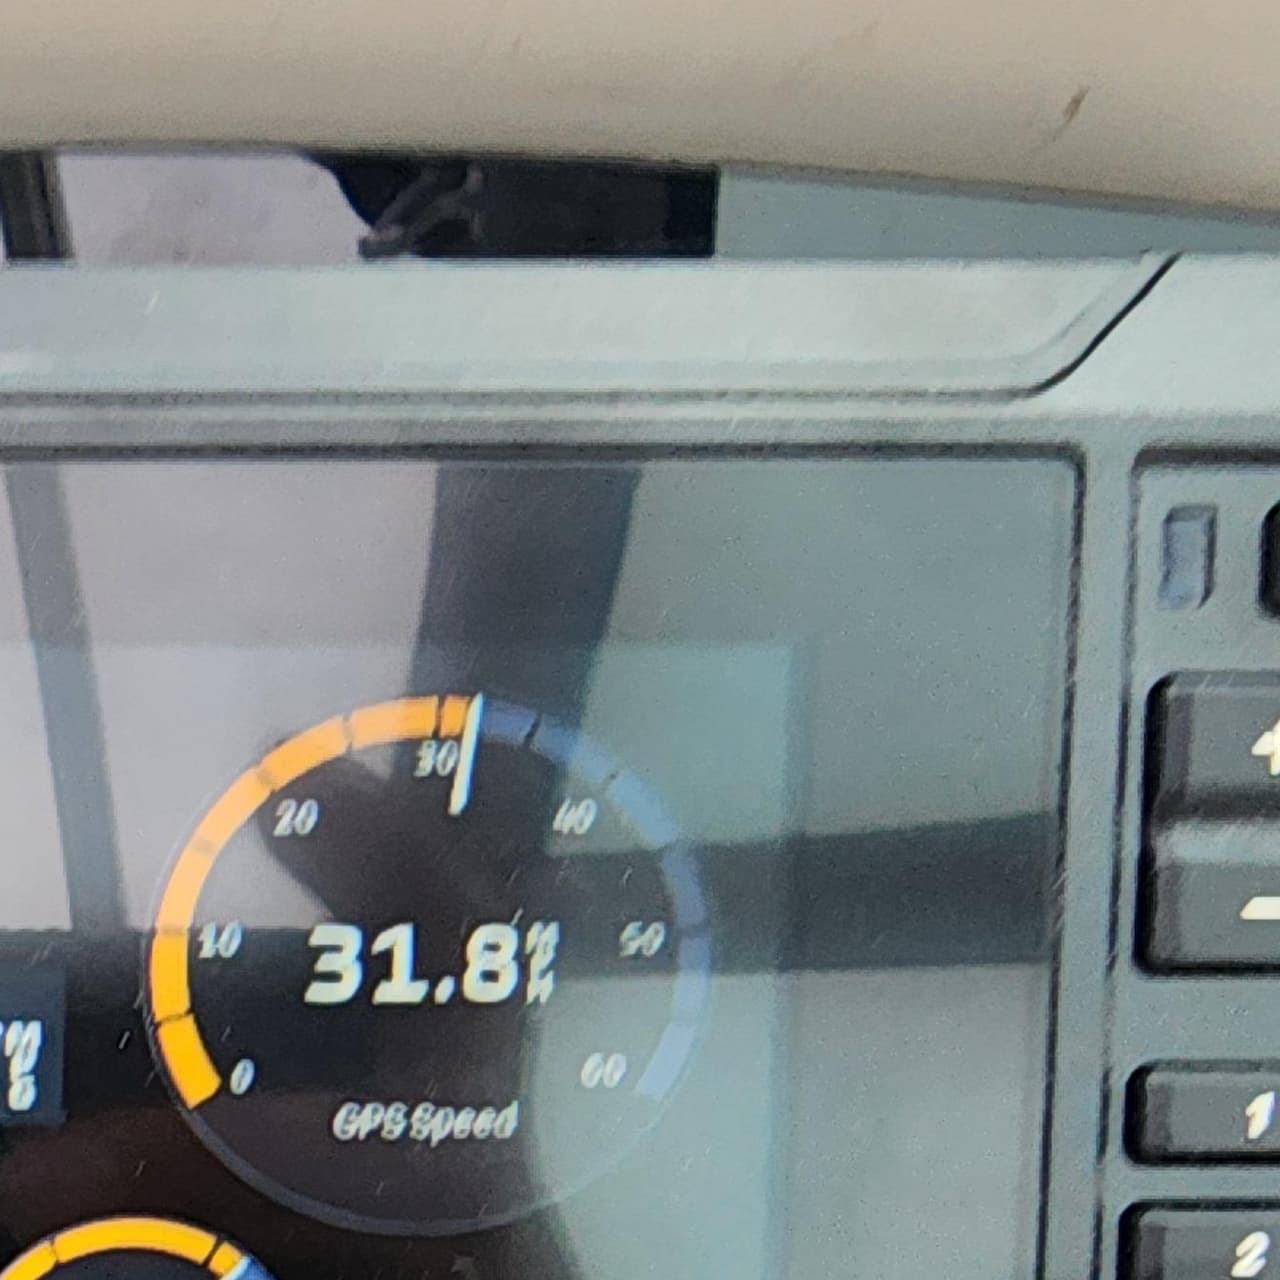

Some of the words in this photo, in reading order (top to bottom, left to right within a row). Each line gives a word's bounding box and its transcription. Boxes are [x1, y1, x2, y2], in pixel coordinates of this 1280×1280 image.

[414, 740, 456, 777] 30
[273, 800, 319, 836] 20
[553, 799, 597, 834] 40
[197, 922, 242, 959] 10
[619, 921, 664, 957] 50
[305, 923, 519, 1004] 31.8
[230, 1059, 254, 1094] 0
[580, 1052, 626, 1088] 60
[332, 1103, 405, 1140] GPS
[410, 1101, 519, 1148] Speed
[1245, 1091, 1276, 1140] 1
[1231, 1231, 1270, 1278] 2
